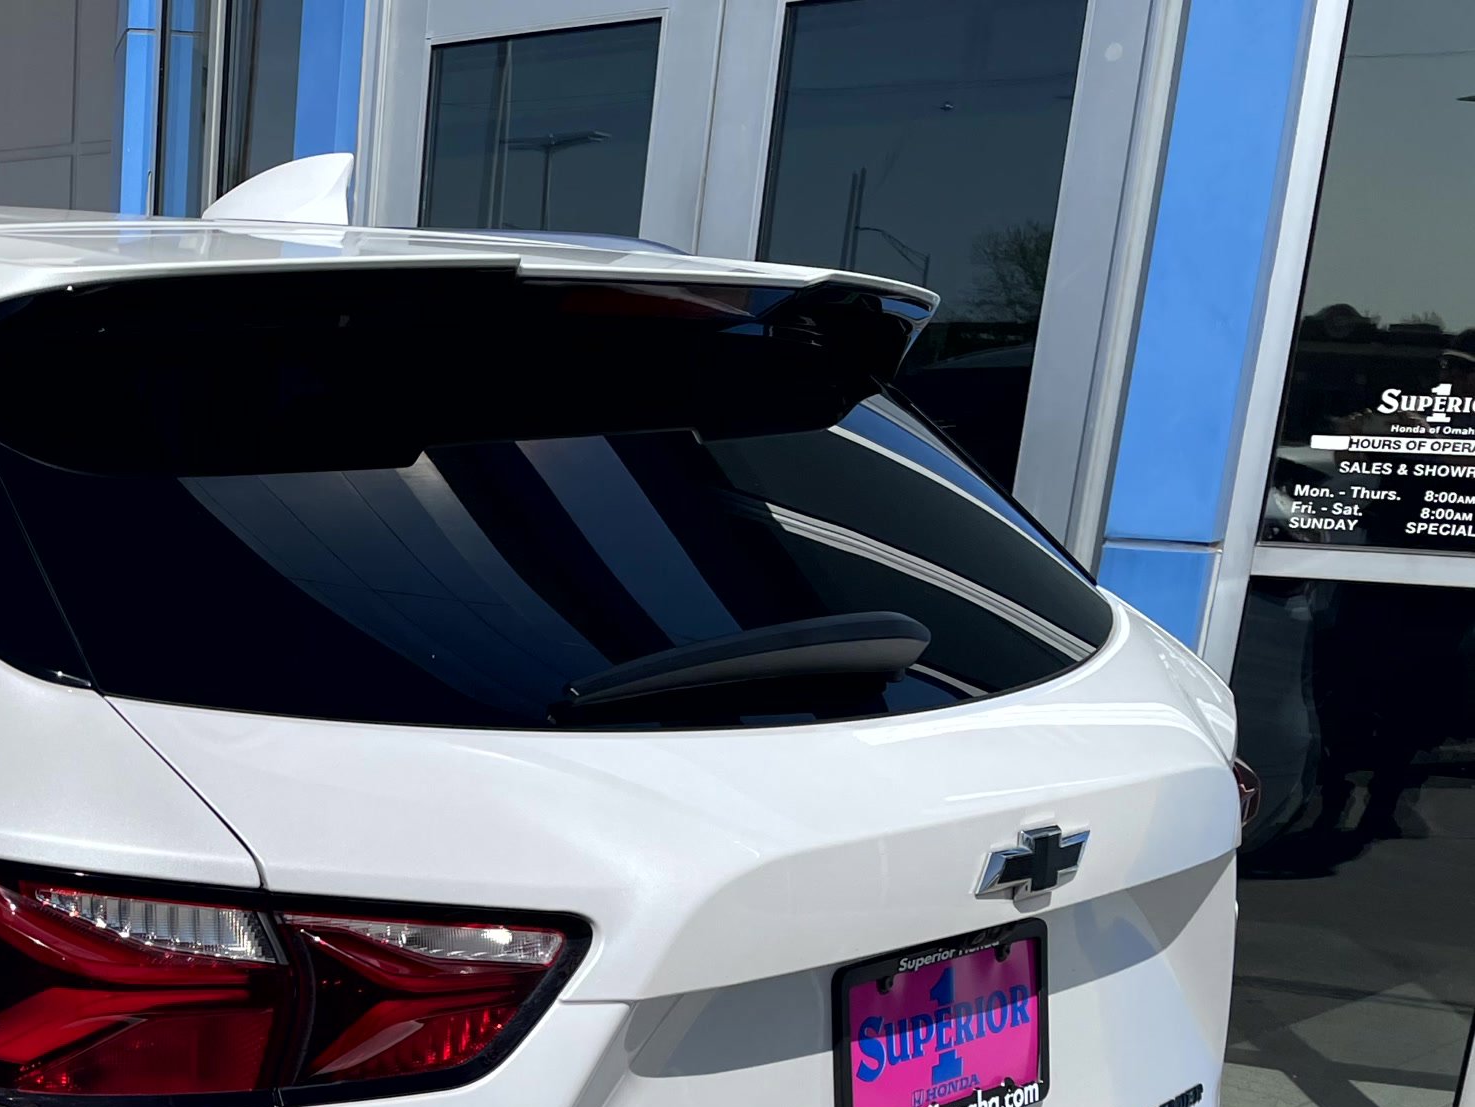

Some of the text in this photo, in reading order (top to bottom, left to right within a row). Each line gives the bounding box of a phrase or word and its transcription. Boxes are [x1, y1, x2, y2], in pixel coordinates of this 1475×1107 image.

[1377, 388, 1475, 414] SUPERI
[1390, 424, 1426, 434] Honda
[1429, 425, 1441, 434] of
[1349, 438, 1402, 450] HOURS
[1406, 440, 1427, 451] OF
[1339, 461, 1393, 475] SALES
[1396, 463, 1409, 476] &
[1293, 484, 1335, 498] Mon.
[1350, 486, 1401, 501] Thurs.
[1424, 490, 1475, 505] 8:00AM
[1290, 501, 1316, 514] Fri.
[1331, 503, 1363, 517] Sat.
[1420, 507, 1473, 521] 8:00AM
[1288, 516, 1475, 537] SUNDAY SPECIAL
[898, 947, 957, 972] Superior
[855, 984, 1031, 1083] SUPERIOR
[926, 1074, 980, 1102] HONDA
